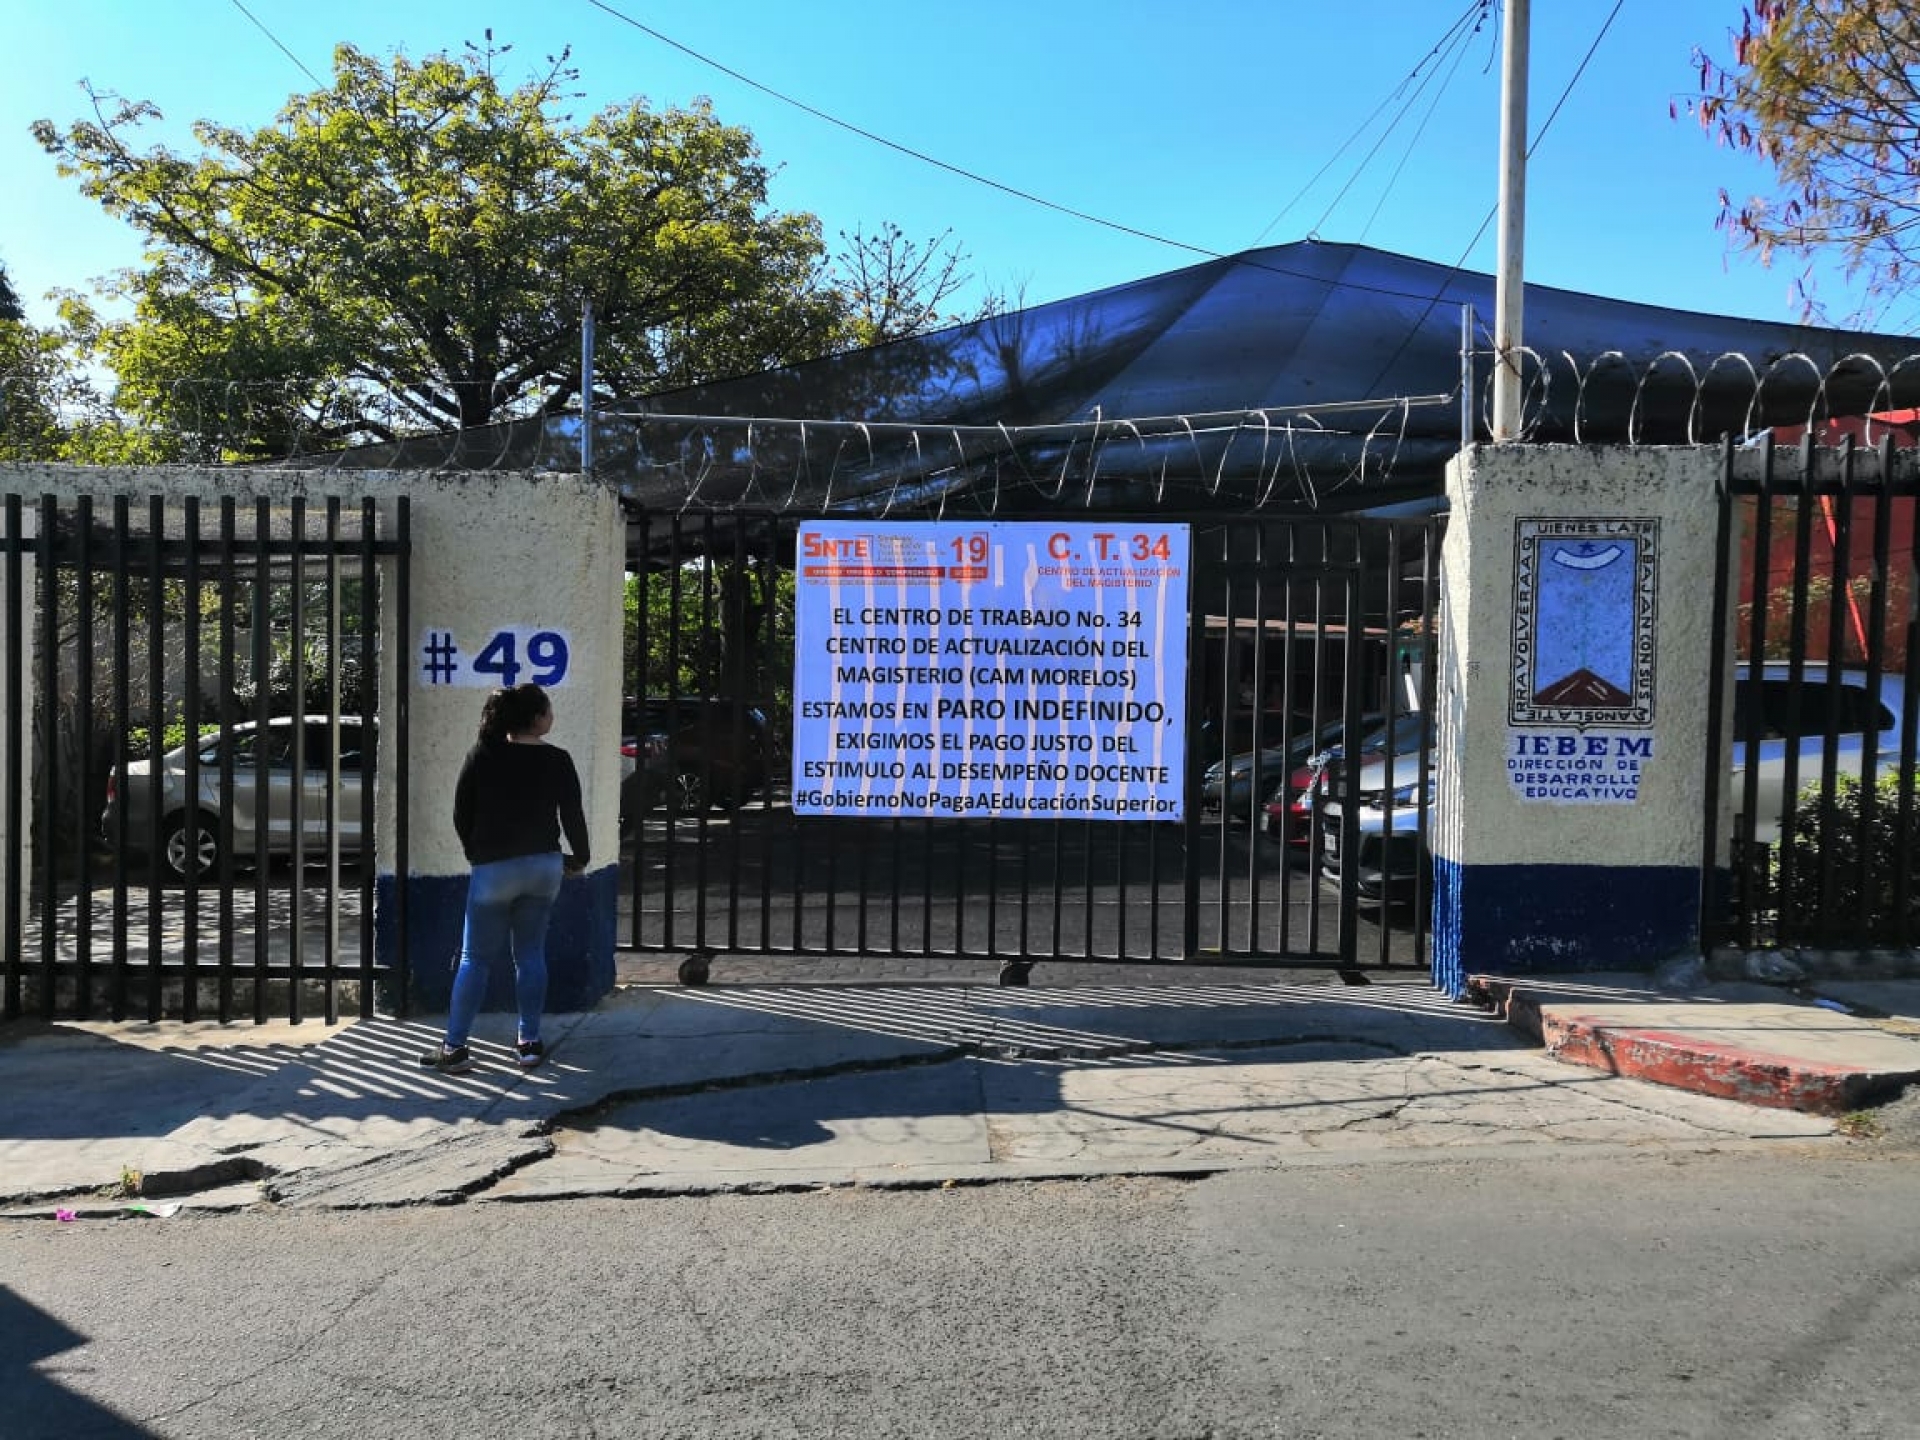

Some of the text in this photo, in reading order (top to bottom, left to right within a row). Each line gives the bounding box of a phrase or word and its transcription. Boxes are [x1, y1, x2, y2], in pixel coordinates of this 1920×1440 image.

[803, 533, 870, 557] SNTE
[950, 536, 987, 563] 19
[1047, 532, 1172, 561] C. T. 34
[1066, 578, 1153, 588] DEL MAGISTERIO
[834, 608, 1142, 628] EL CENTRO DE TRABAJO No. 34
[826, 635, 1149, 658] CENTRO DE ACTUALIZACIÓN DEL
[423, 631, 569, 689] # 49
[837, 666, 1136, 691] MAGISTERIO (CAM MORELOS)
[802, 699, 1173, 726] ESTAMOS EN PARO INDEFINIDO,
[836, 732, 1139, 753] EXIGIMOS EL PAGO JUSTO DEL
[1516, 734, 1653, 758] IEBEM
[804, 760, 1168, 784] ESTIMULO AL DESEMPEÑO DOCENTE
[1508, 756, 1639, 770] DIRECCIÓN DE
[796, 789, 1177, 815] #GobiernoNoPagaAEducaciónSuperior
[1526, 786, 1638, 799] EDUCATIVO
